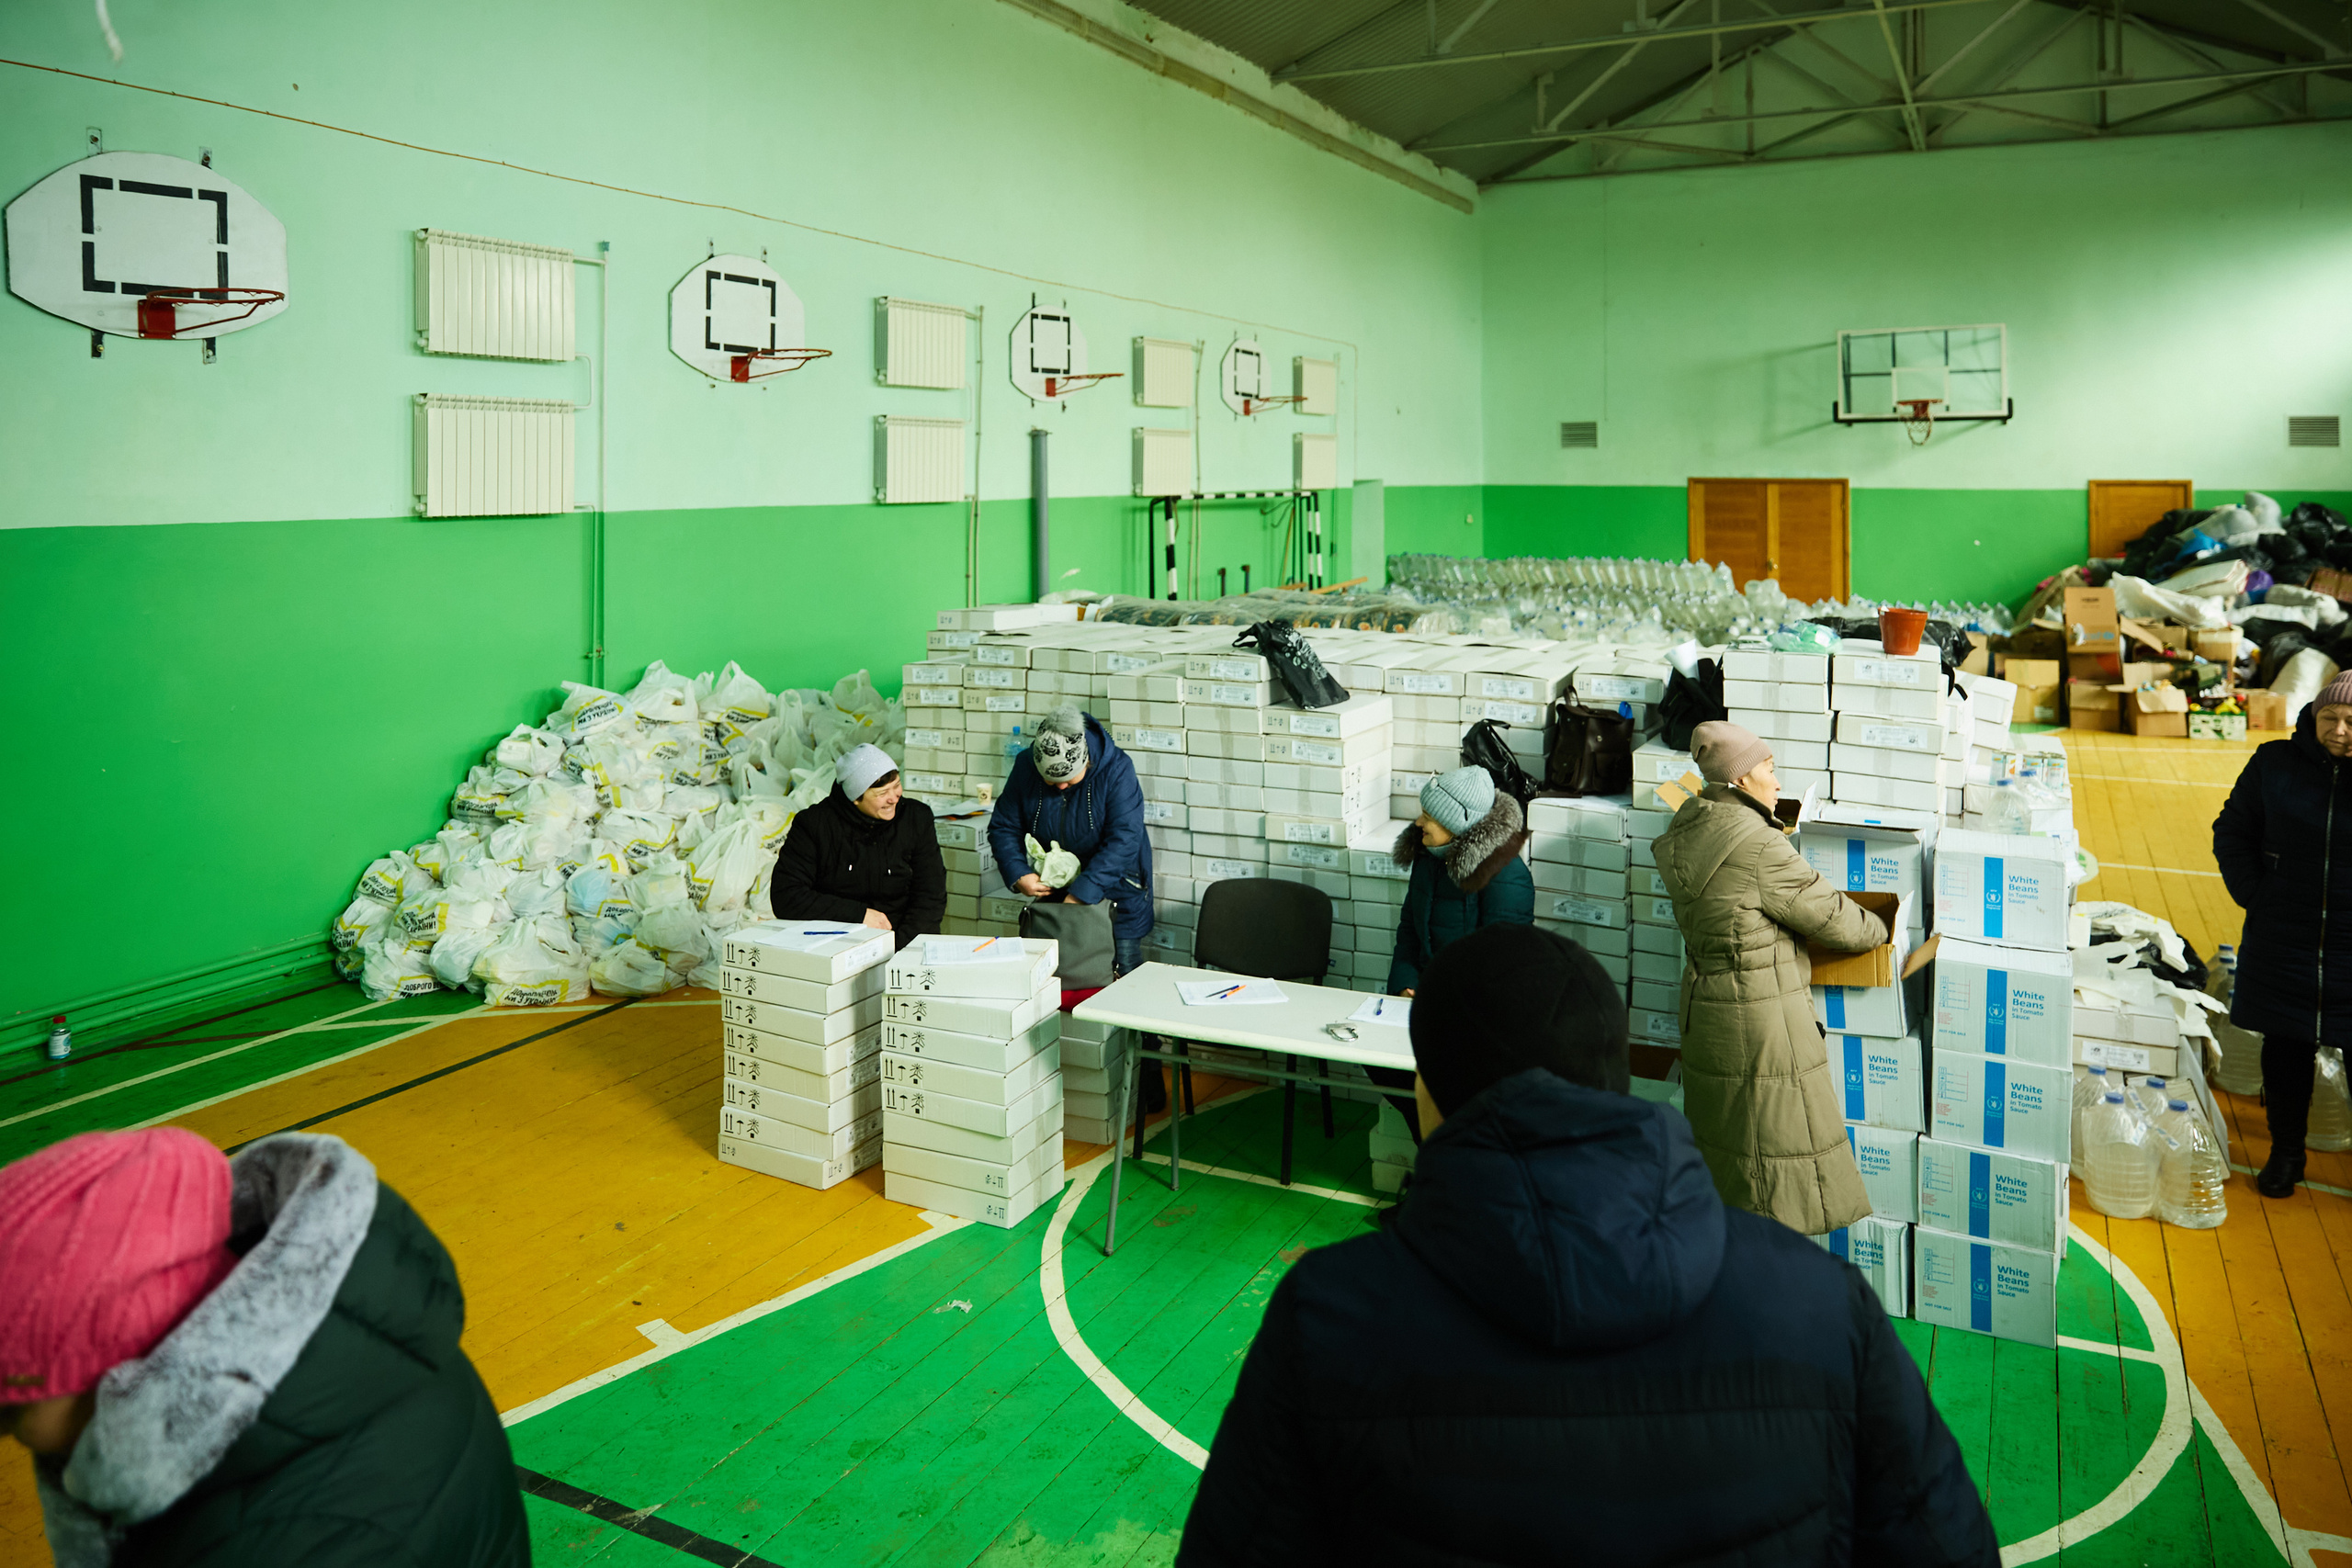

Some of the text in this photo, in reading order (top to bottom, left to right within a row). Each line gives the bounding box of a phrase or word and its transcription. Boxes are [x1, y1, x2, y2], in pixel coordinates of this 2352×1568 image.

[1871, 857, 1899, 866] White
[1871, 865, 1899, 874] Beans
[2008, 875, 2040, 886] White
[2008, 884, 2039, 894] Beans
[404, 982, 433, 991] ДОБРОГО
[2012, 989, 2045, 1001] White
[2012, 998, 2044, 1010] Beans
[2019, 1009, 2044, 1017] Tomato
[1868, 1055, 1898, 1066] White
[1868, 1064, 1898, 1074] Beans
[2010, 1082, 2043, 1095] White
[2010, 1091, 2042, 1103] Beans
[2009, 1106, 2029, 1114] Sauce
[2018, 1100, 2042, 1111] Tomato
[1860, 1145, 1891, 1156] White
[1860, 1154, 1891, 1165] Beans
[1868, 1163, 1891, 1172] Tomato
[1996, 1174, 2028, 1188] White
[1996, 1182, 2027, 1196] Beans
[1995, 1198, 2014, 1206] Sauce
[2003, 1193, 2027, 1203] Tomato
[1854, 1239, 1883, 1251] White
[1854, 1247, 1883, 1259] Beans
[1861, 1258, 1883, 1266] Tomato
[1997, 1265, 2030, 1279] White
[1997, 1274, 2030, 1287] Beans
[1996, 1289, 2016, 1298] Sauce
[2005, 1284, 2030, 1294] Tomato
